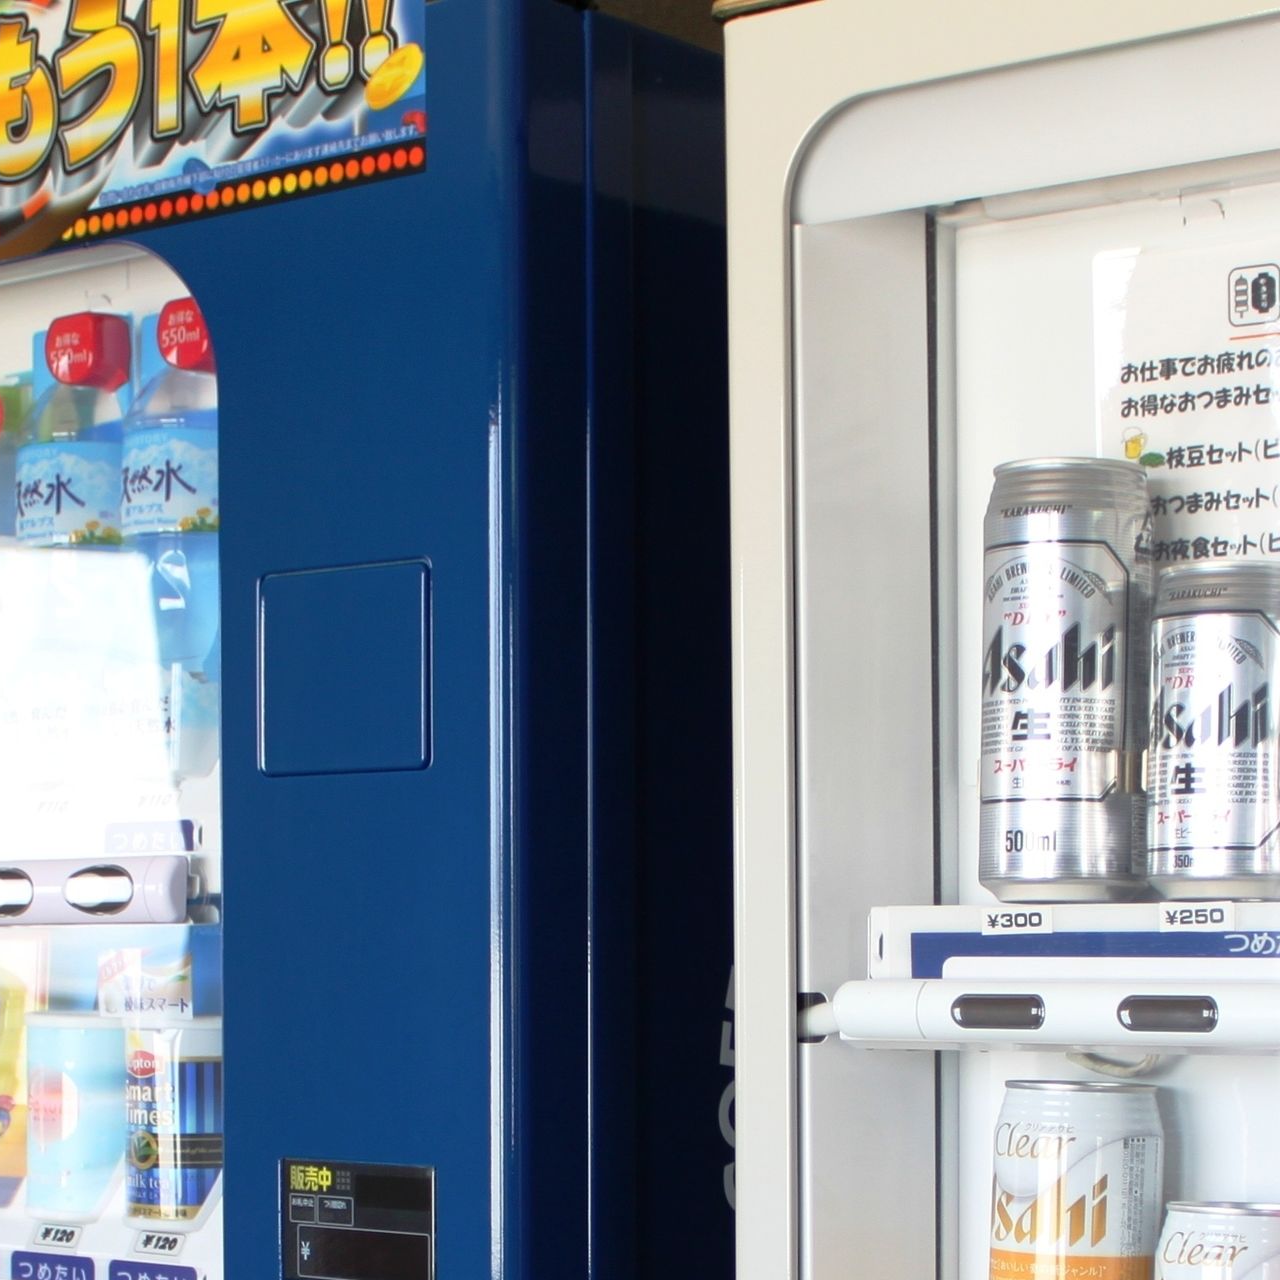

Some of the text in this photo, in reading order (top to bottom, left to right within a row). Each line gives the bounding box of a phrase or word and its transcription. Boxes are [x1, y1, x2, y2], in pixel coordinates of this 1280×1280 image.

[161, 328, 200, 347] 550ml
[1060, 566, 1096, 599] LIMITED
[982, 621, 1117, 696] Asahi
[1011, 707, 1052, 741] 生
[993, 756, 1079, 774] スーパライ
[1170, 762, 1207, 795] 生
[986, 911, 1044, 929] ¥300
[1165, 907, 1225, 926] ¥250
[995, 1121, 1078, 1160] Clear
[290, 1164, 332, 1192] 販売中
[39, 1227, 76, 1244] ¥120
[141, 1234, 179, 1252] ¥120
[301, 1240, 312, 1261] ¥
[1163, 1231, 1249, 1268] Clear
